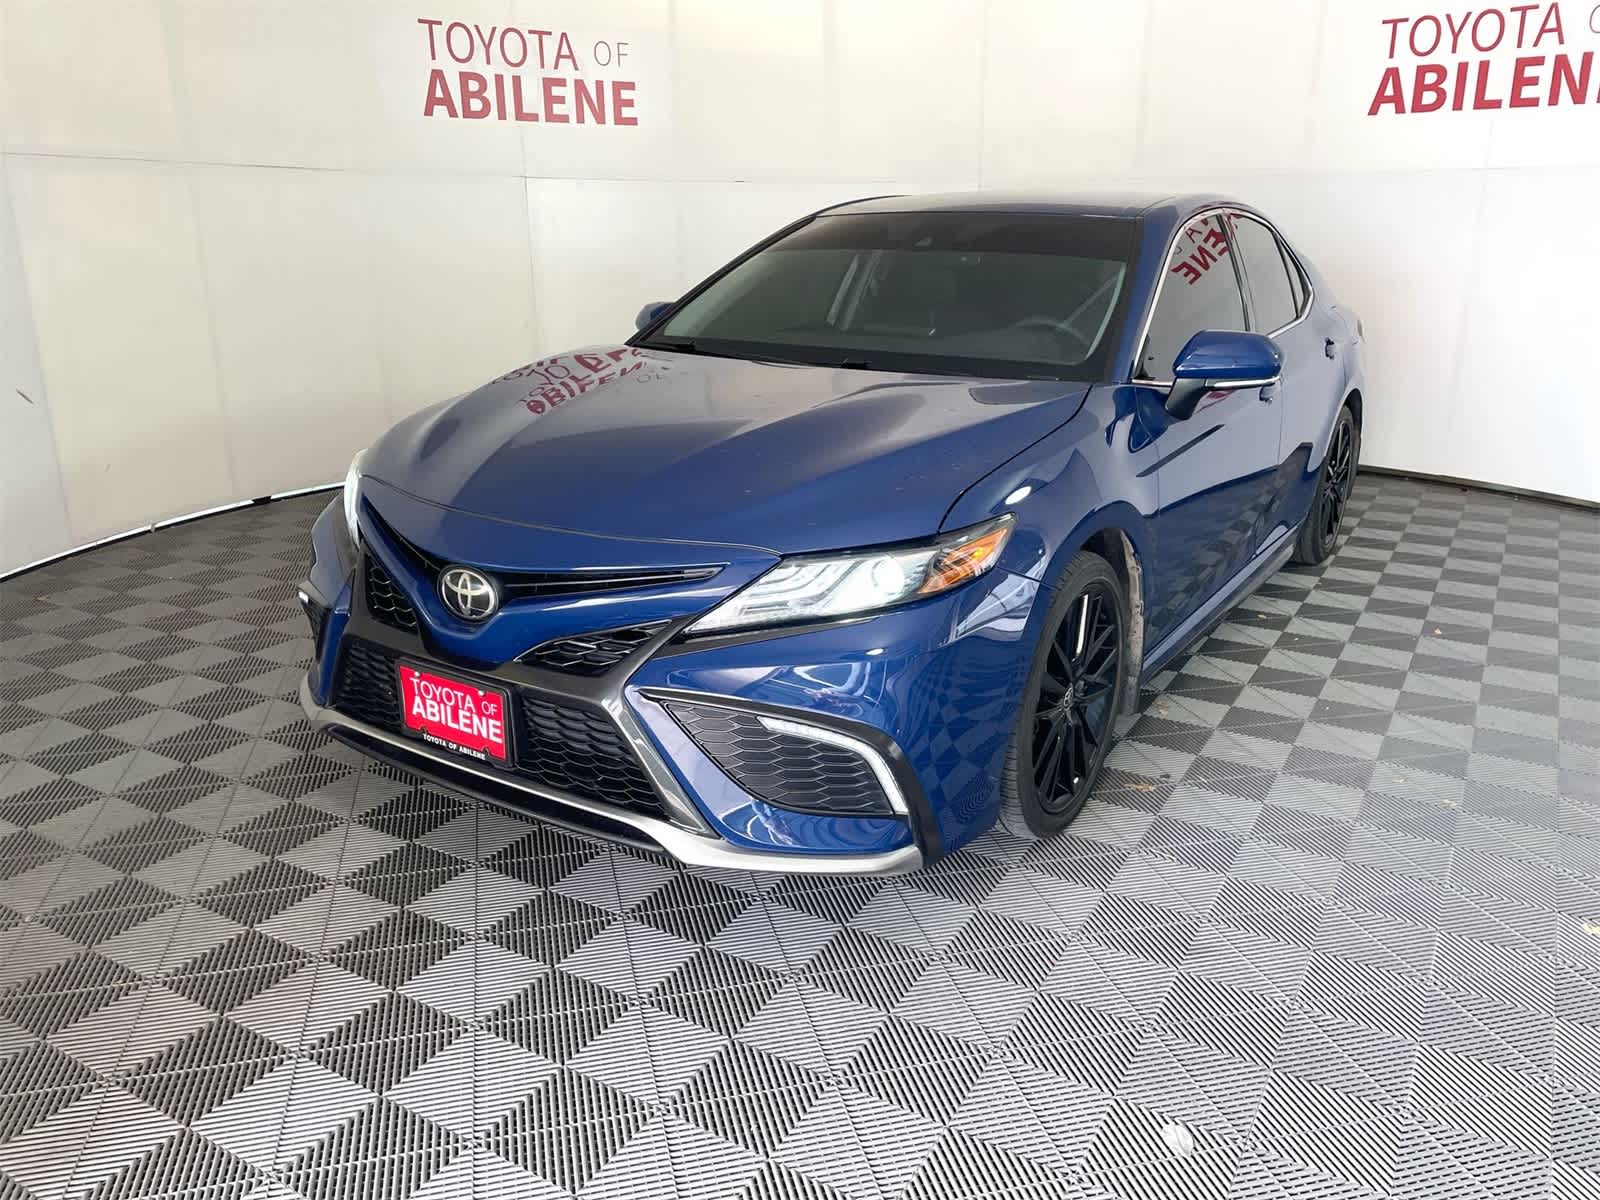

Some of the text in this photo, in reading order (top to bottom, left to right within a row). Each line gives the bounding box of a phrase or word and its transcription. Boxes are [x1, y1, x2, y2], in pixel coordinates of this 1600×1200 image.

[417, 18, 629, 71] TOYOTA OF
[1382, 2, 1565, 59] TOYOTA
[423, 68, 638, 126] ABILENE
[1367, 51, 1600, 116] ABILEN
[409, 677, 498, 716] TOYOTA OF
[412, 695, 503, 744] ABILENE
[422, 733, 486, 761] TOYOTA OF ABILENE
